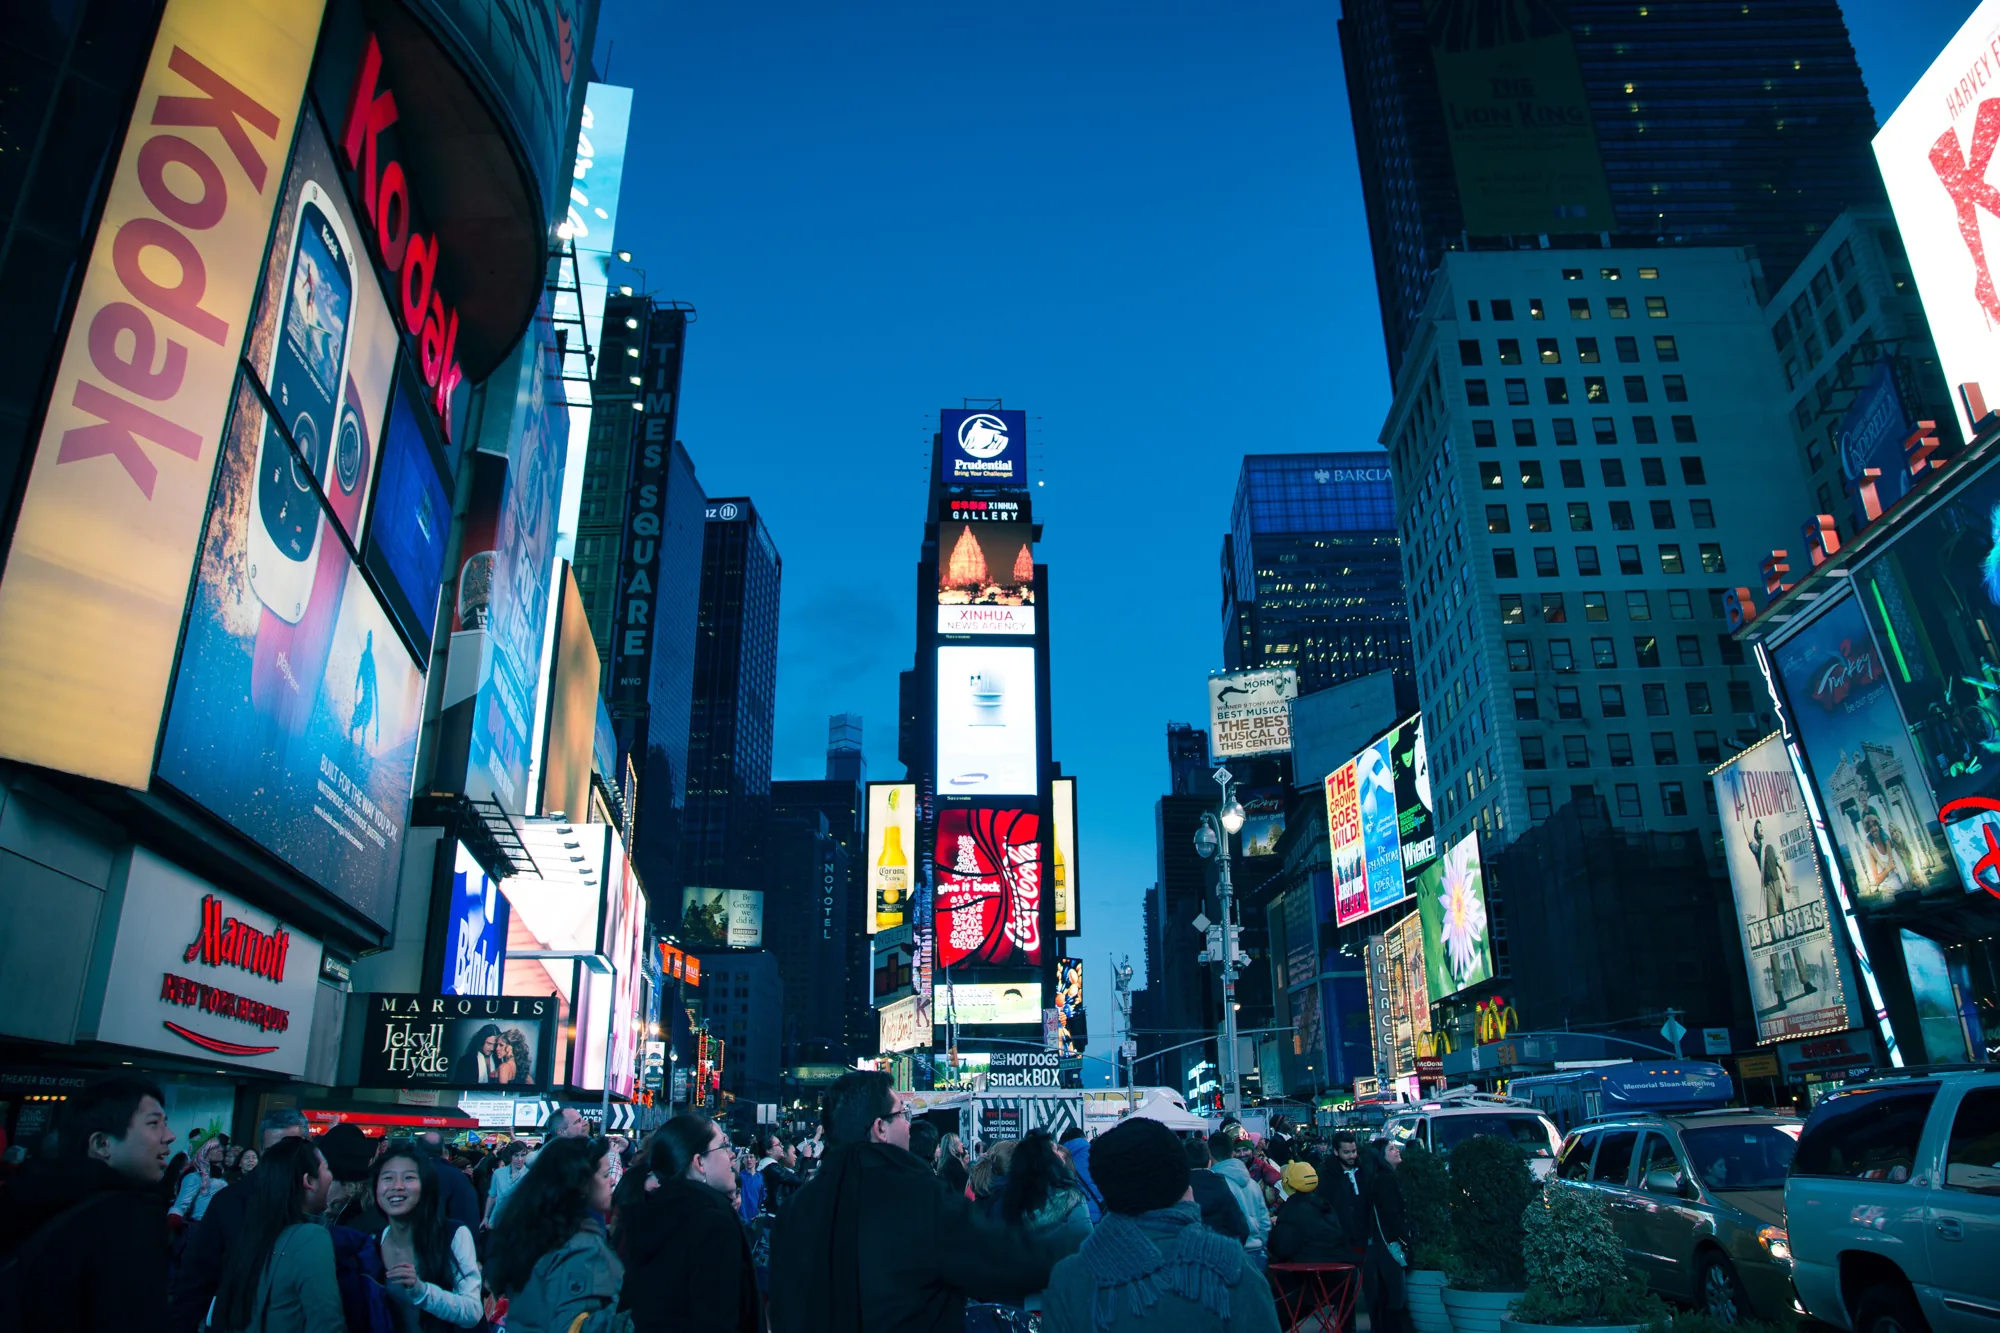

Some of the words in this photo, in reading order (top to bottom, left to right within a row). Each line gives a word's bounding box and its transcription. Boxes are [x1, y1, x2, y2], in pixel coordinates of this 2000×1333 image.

[1946, 52, 1992, 120] HARVEY
[321, 224, 339, 262] Kodak
[339, 31, 465, 445] Kodak
[56, 43, 281, 502] Kodak
[643, 343, 675, 469] TIMES
[954, 459, 1013, 471] Prudential
[952, 511, 1018, 520] GALLERY
[988, 502, 1018, 510] XINHUA
[623, 484, 661, 656] SQUARE
[960, 610, 1014, 621] XINHUA
[947, 621, 979, 630] NEWS
[982, 622, 1027, 632] AGENCY
[620, 677, 642, 686] NYC
[1817, 652, 1874, 694] Turkey
[1248, 700, 1266, 708] TONY
[1844, 703, 1856, 714] be
[1217, 710, 1243, 720] BEST
[1218, 728, 1275, 743] MUSICAL
[1220, 742, 1243, 751] THIS
[1327, 764, 1355, 796] THE
[320, 753, 339, 784] BUILT
[338, 771, 352, 797] FOR
[351, 782, 363, 808] THE
[362, 795, 376, 820] WAY
[374, 807, 387, 831] YOU
[1329, 789, 1357, 813] CROWD
[1331, 802, 1358, 832] GOES
[1332, 820, 1360, 850] WILD!
[1367, 849, 1399, 873] PHANTOM
[879, 867, 905, 876] Corona
[937, 882, 960, 894] give
[962, 881, 970, 892] it
[972, 881, 1000, 892] back
[1373, 875, 1395, 893] OPERA
[742, 893, 752, 903] By
[823, 863, 834, 939] NOVOTEL
[1749, 902, 1823, 947] NEWSIES
[182, 894, 290, 983] Marriott
[454, 917, 488, 996] Bank
[1376, 944, 1393, 1045] PALACE
[381, 998, 544, 1014] MARQUIS
[382, 1022, 444, 1054] Jekyll
[387, 1047, 449, 1078] Hyde
[1007, 1053, 1028, 1066] HOT
[1029, 1053, 1059, 1066] DOGS
[1, 1074, 37, 1084] THEATER
[39, 1076, 57, 1086] BOX
[58, 1077, 86, 1088] OFFICE
[990, 1068, 1060, 1087] snackBOX
[1848, 1067, 1870, 1077] SONY
[1623, 1082, 1658, 1090] Memorial
[1659, 1080, 1716, 1089] Sloan-Kettering
